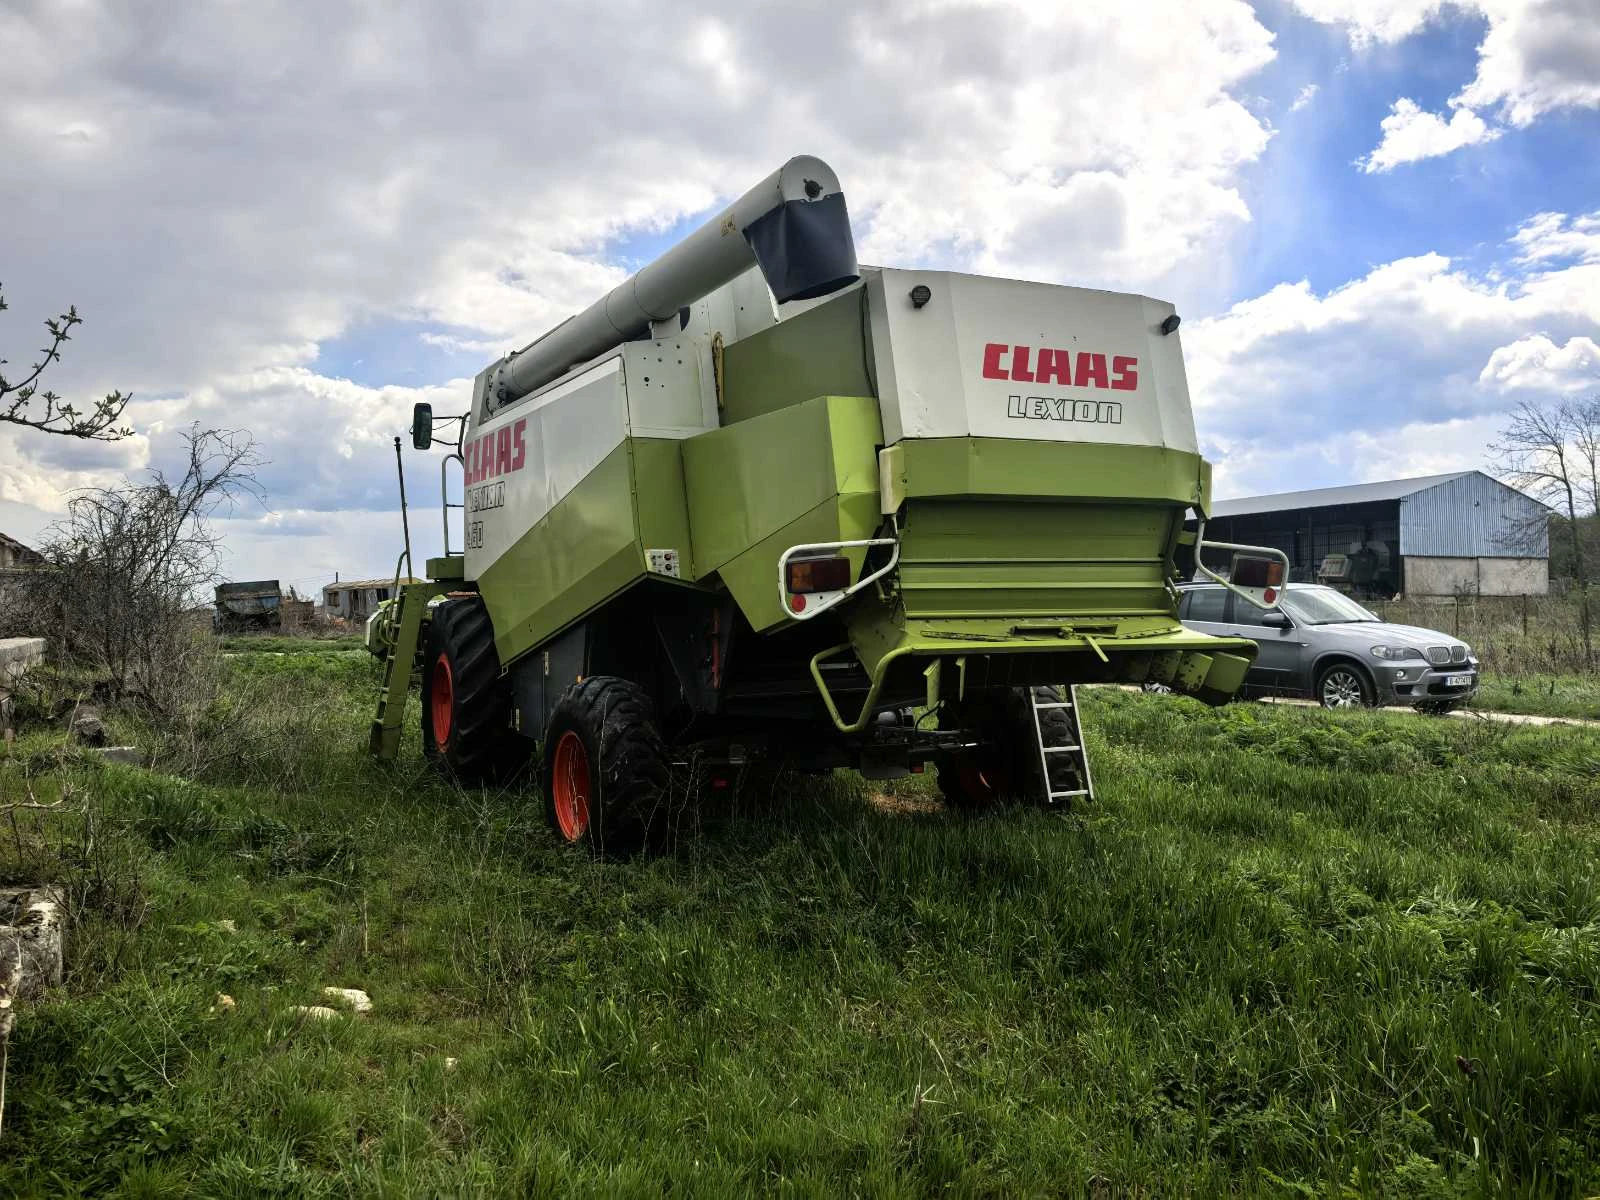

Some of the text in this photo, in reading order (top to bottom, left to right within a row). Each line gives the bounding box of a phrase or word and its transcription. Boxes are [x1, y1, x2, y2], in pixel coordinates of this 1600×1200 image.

[982, 343, 1138, 391] CLAAS
[1007, 395, 1122, 424] LEXION
[464, 418, 526, 486] CLAAS
